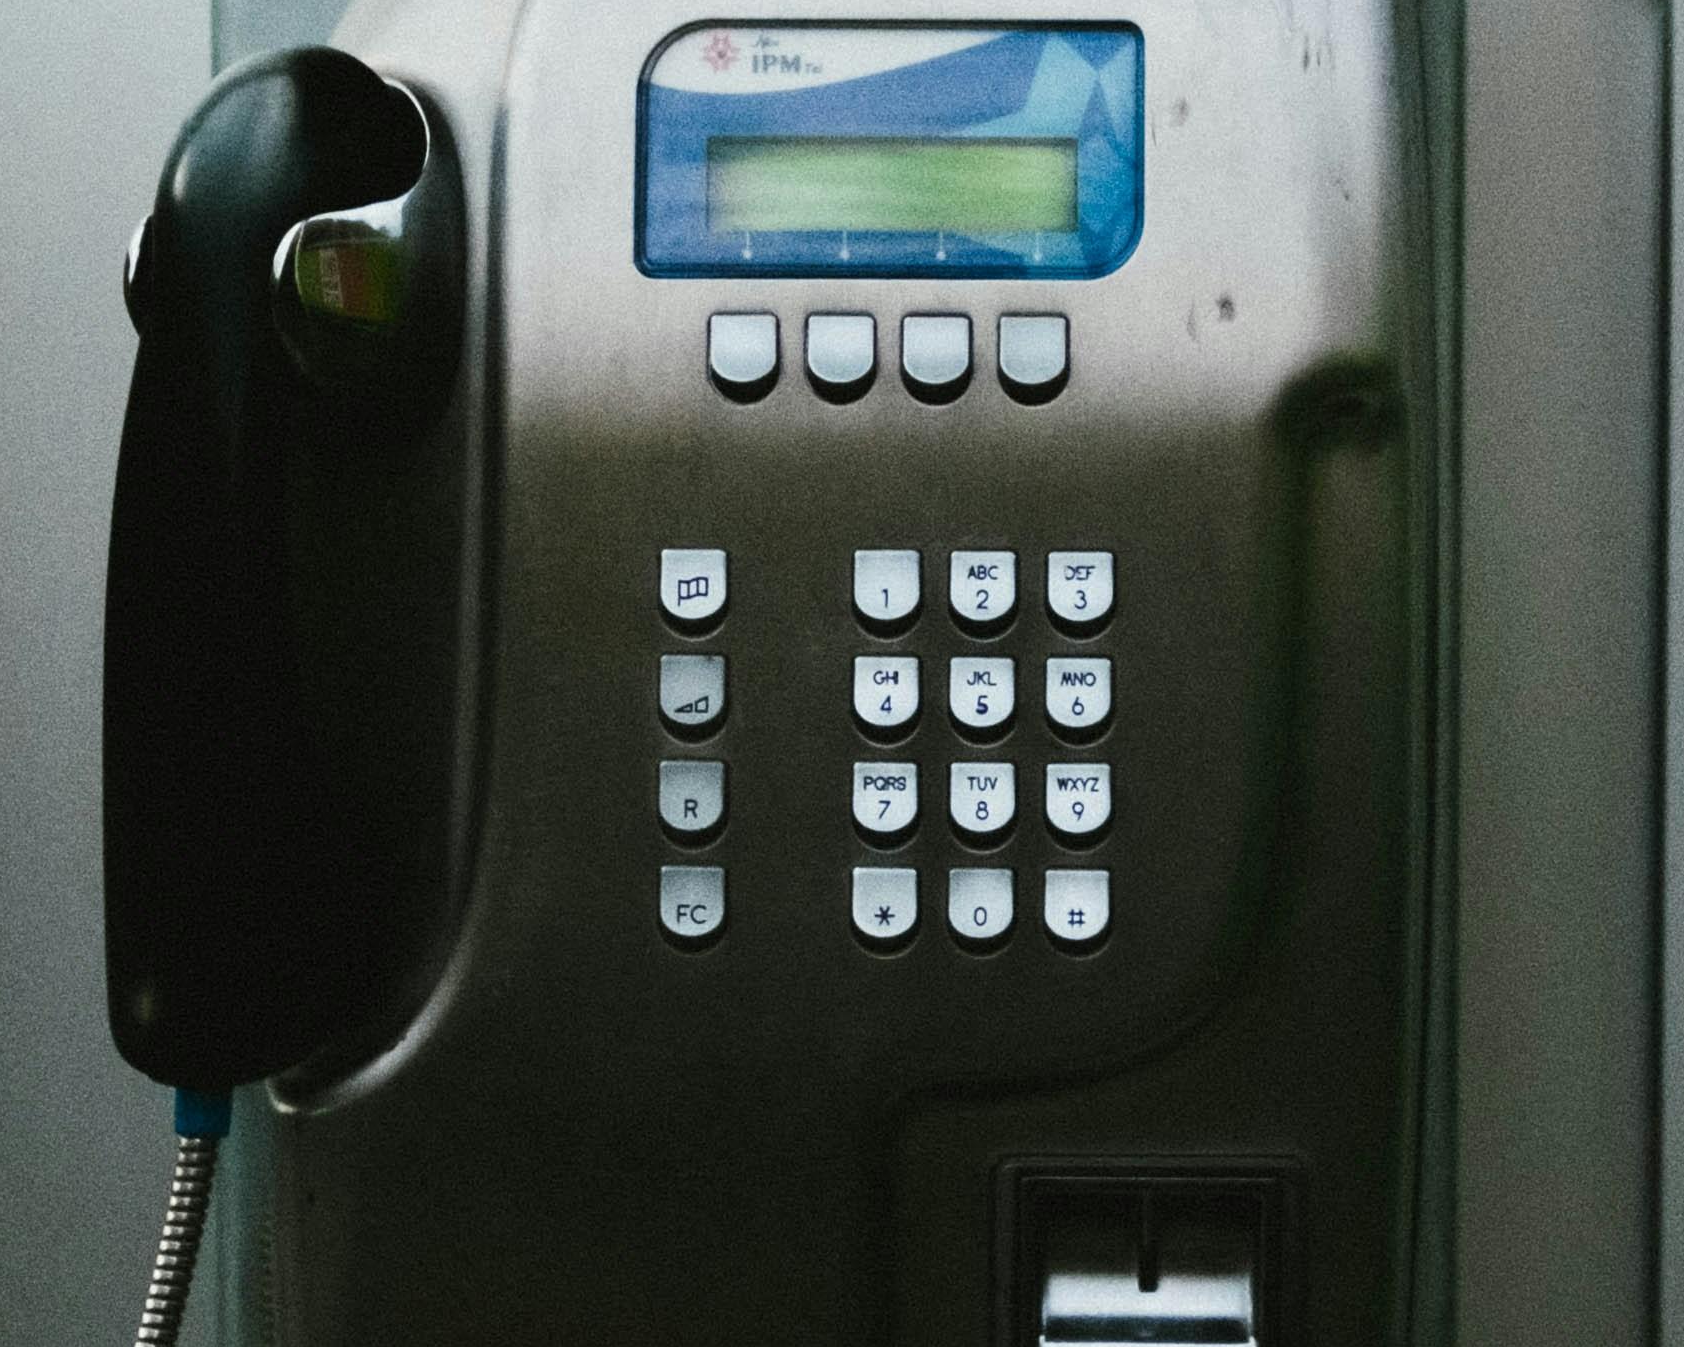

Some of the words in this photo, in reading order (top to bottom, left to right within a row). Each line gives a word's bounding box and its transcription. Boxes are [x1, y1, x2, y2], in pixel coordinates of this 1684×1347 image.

[751, 54, 802, 75] IPM
[967, 564, 998, 581] ABC
[1064, 564, 1096, 582] DEF
[881, 588, 889, 608] 1
[976, 588, 989, 611] 2
[1074, 589, 1088, 611] 3
[872, 669, 900, 685] GHI
[966, 670, 997, 687] JKL
[1060, 671, 1097, 687] MNO
[879, 695, 893, 714] 4
[975, 694, 989, 716] 5
[1071, 696, 1085, 717] 6
[862, 774, 907, 792] PQRS
[966, 775, 998, 792] TUV
[1056, 776, 1100, 793] WXYZ
[683, 797, 699, 819] R
[878, 799, 892, 819] 7
[975, 800, 990, 822] 8
[1071, 800, 1085, 820] 9
[675, 903, 708, 925] FC
[972, 905, 988, 928] 0
